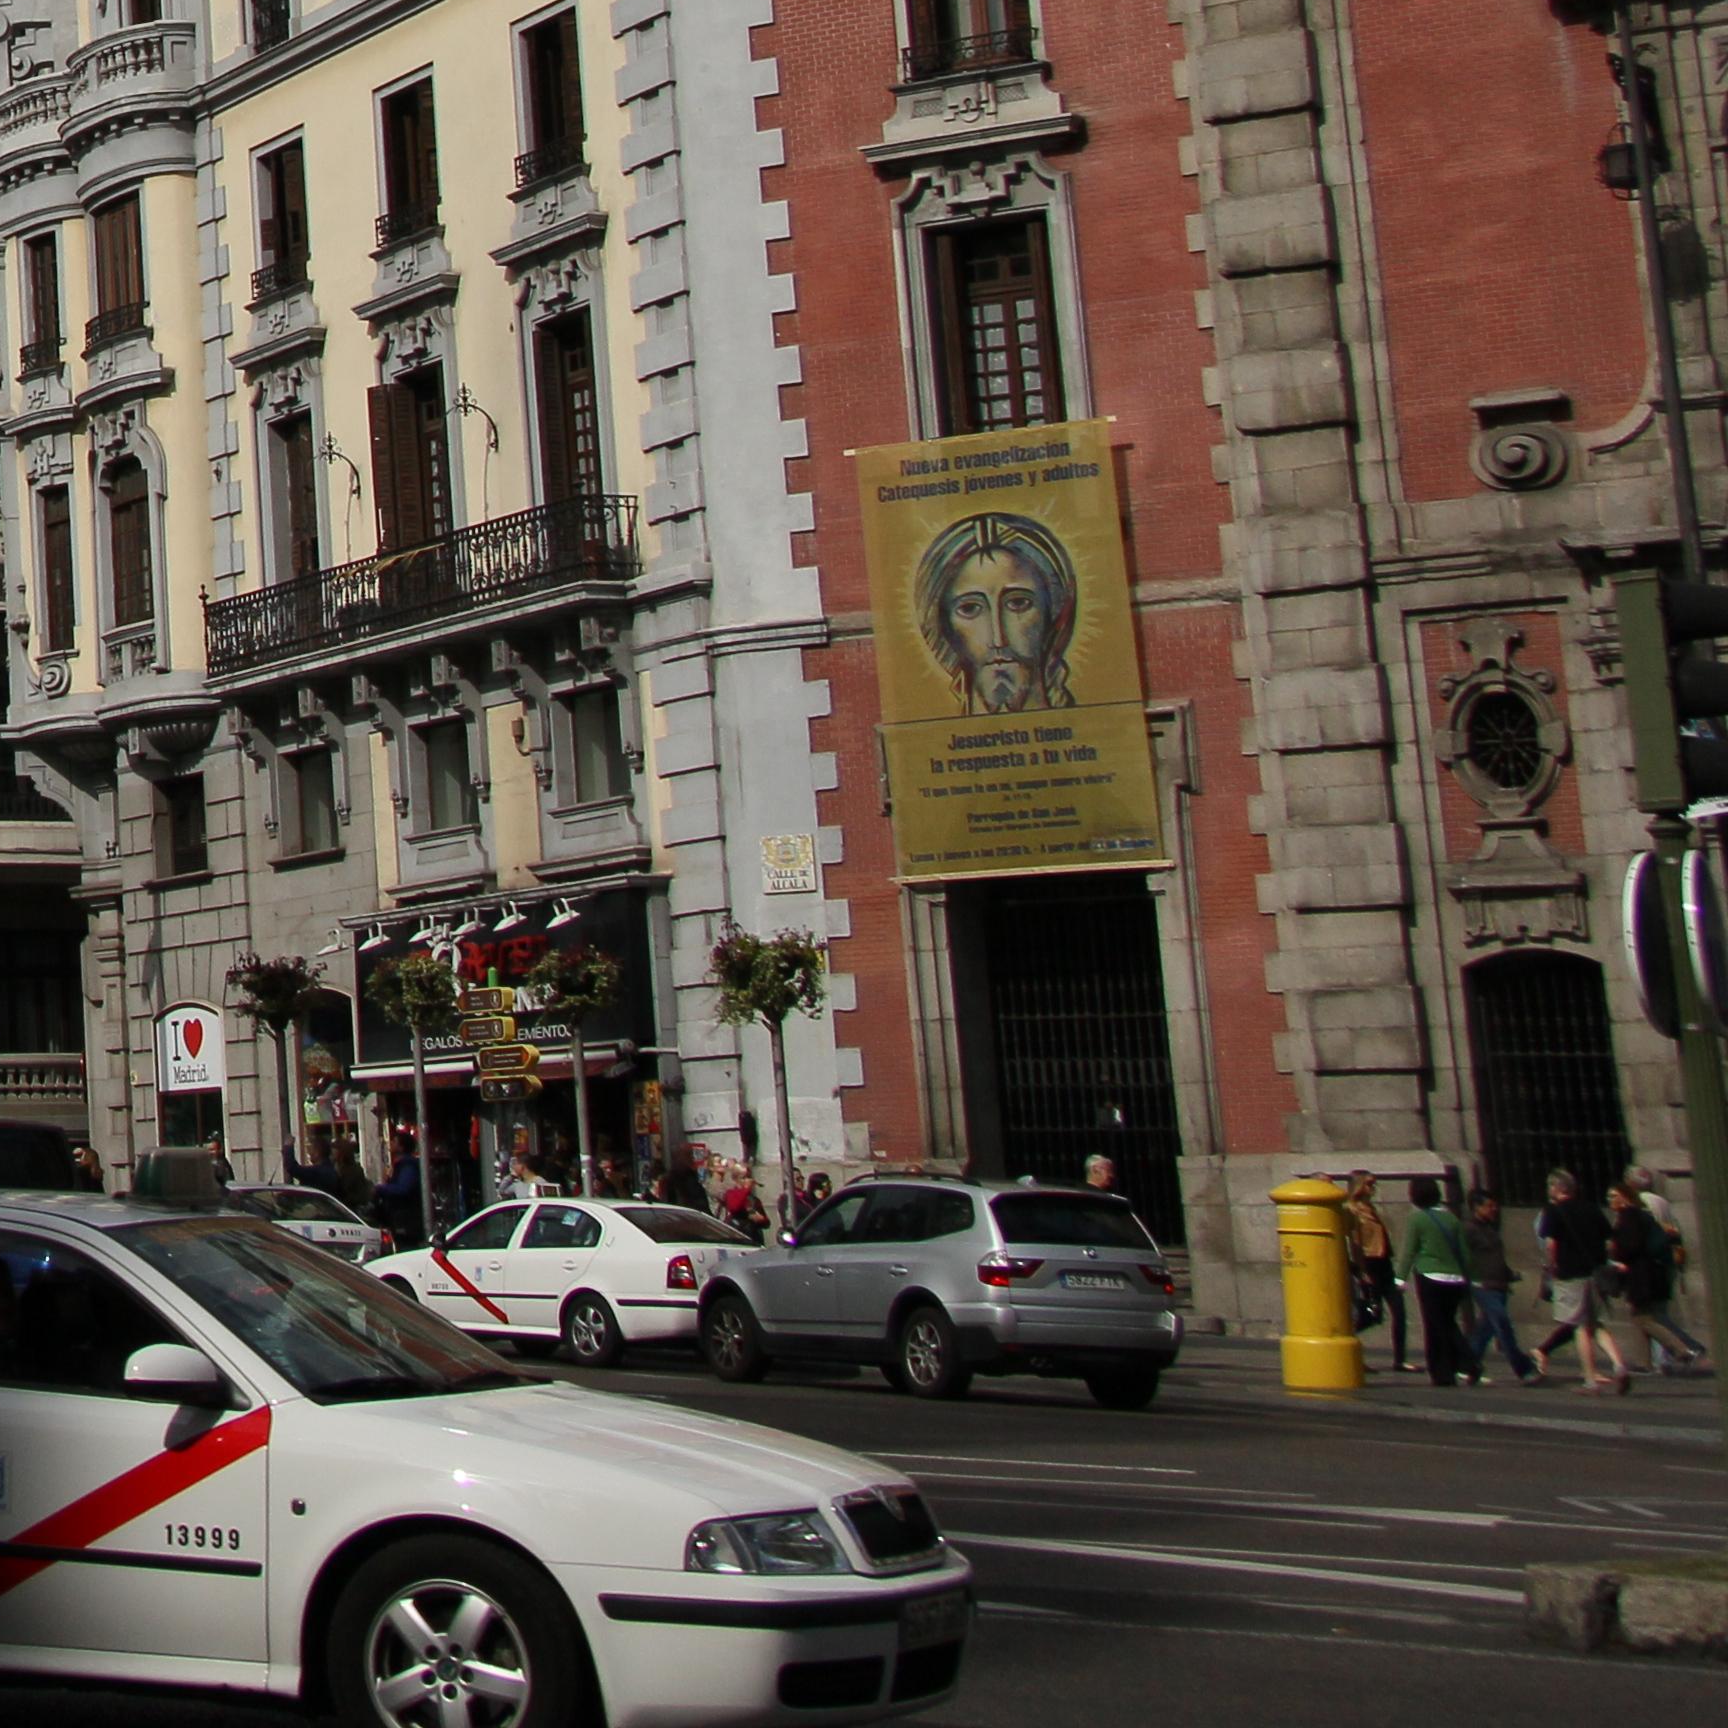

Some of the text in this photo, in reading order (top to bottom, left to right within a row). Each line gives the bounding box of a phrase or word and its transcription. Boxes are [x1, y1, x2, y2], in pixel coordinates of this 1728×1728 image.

[901, 456, 949, 476] Nueva
[878, 461, 1100, 503] Catequesis jóvenes y adultos
[948, 726, 1072, 751] Jesucristo tiene
[930, 745, 1097, 773] la respuesta a tu vida
[768, 869, 797, 879] CALLE
[171, 1021, 181, 1061] I
[165, 1524, 240, 1550] 13999
